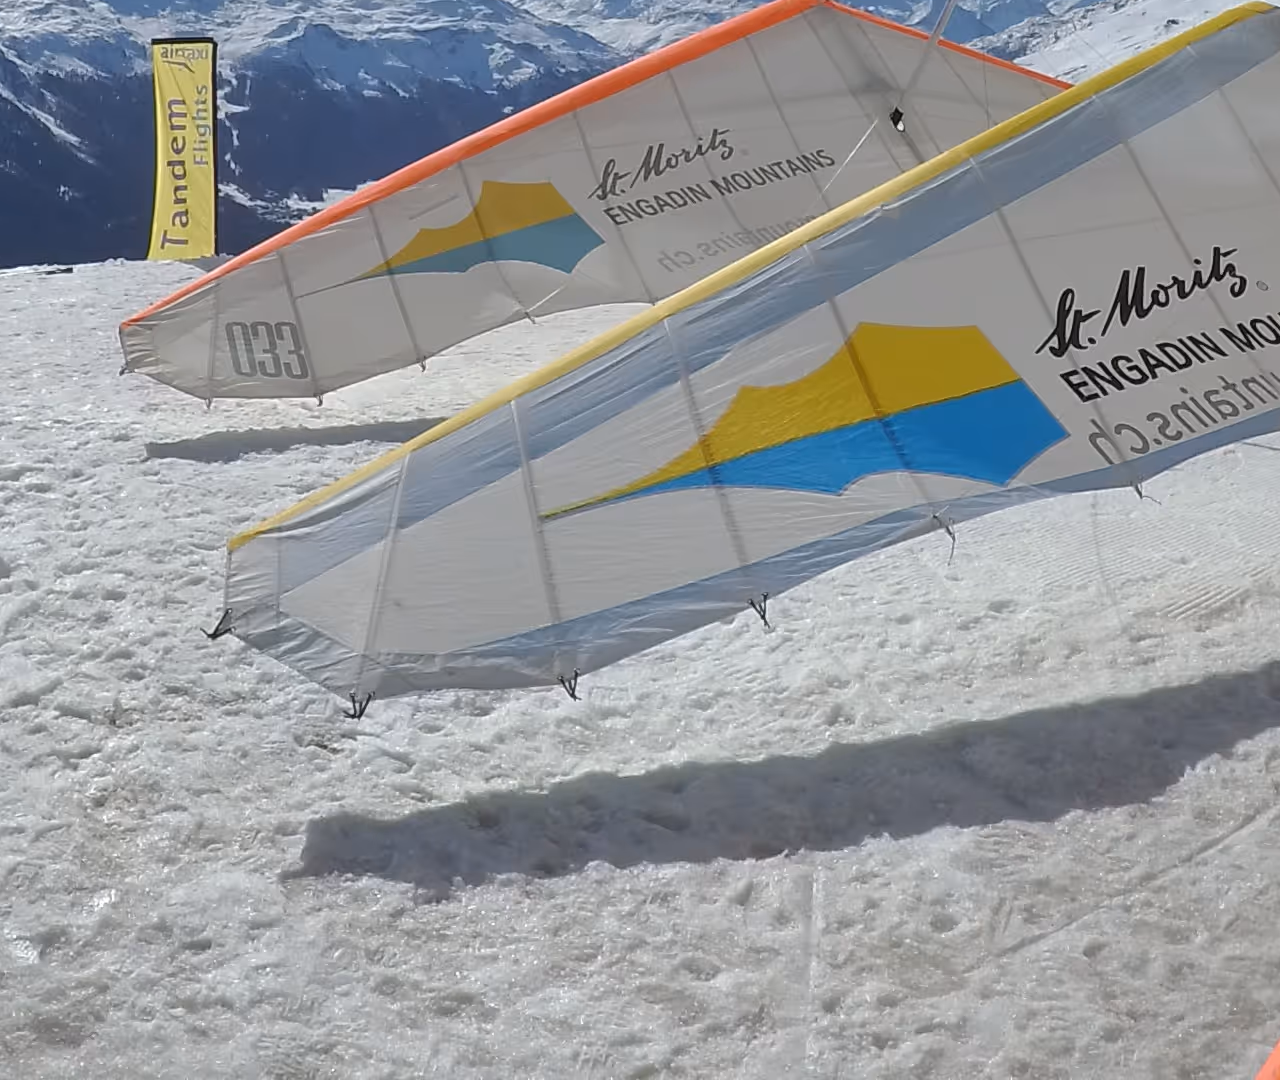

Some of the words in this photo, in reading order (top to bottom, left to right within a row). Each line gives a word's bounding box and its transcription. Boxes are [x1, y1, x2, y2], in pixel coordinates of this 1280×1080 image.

[191, 84, 211, 166] Flights
[629, 128, 734, 189] Moritz
[160, 98, 189, 250] Tandem
[603, 183, 713, 226] ENGADIN
[709, 149, 836, 196] MOUNTAINS
[1034, 288, 1101, 358] St.
[1101, 246, 1248, 338] Moritz
[225, 321, 309, 379] 033
[1059, 331, 1226, 403] ENGADIN
